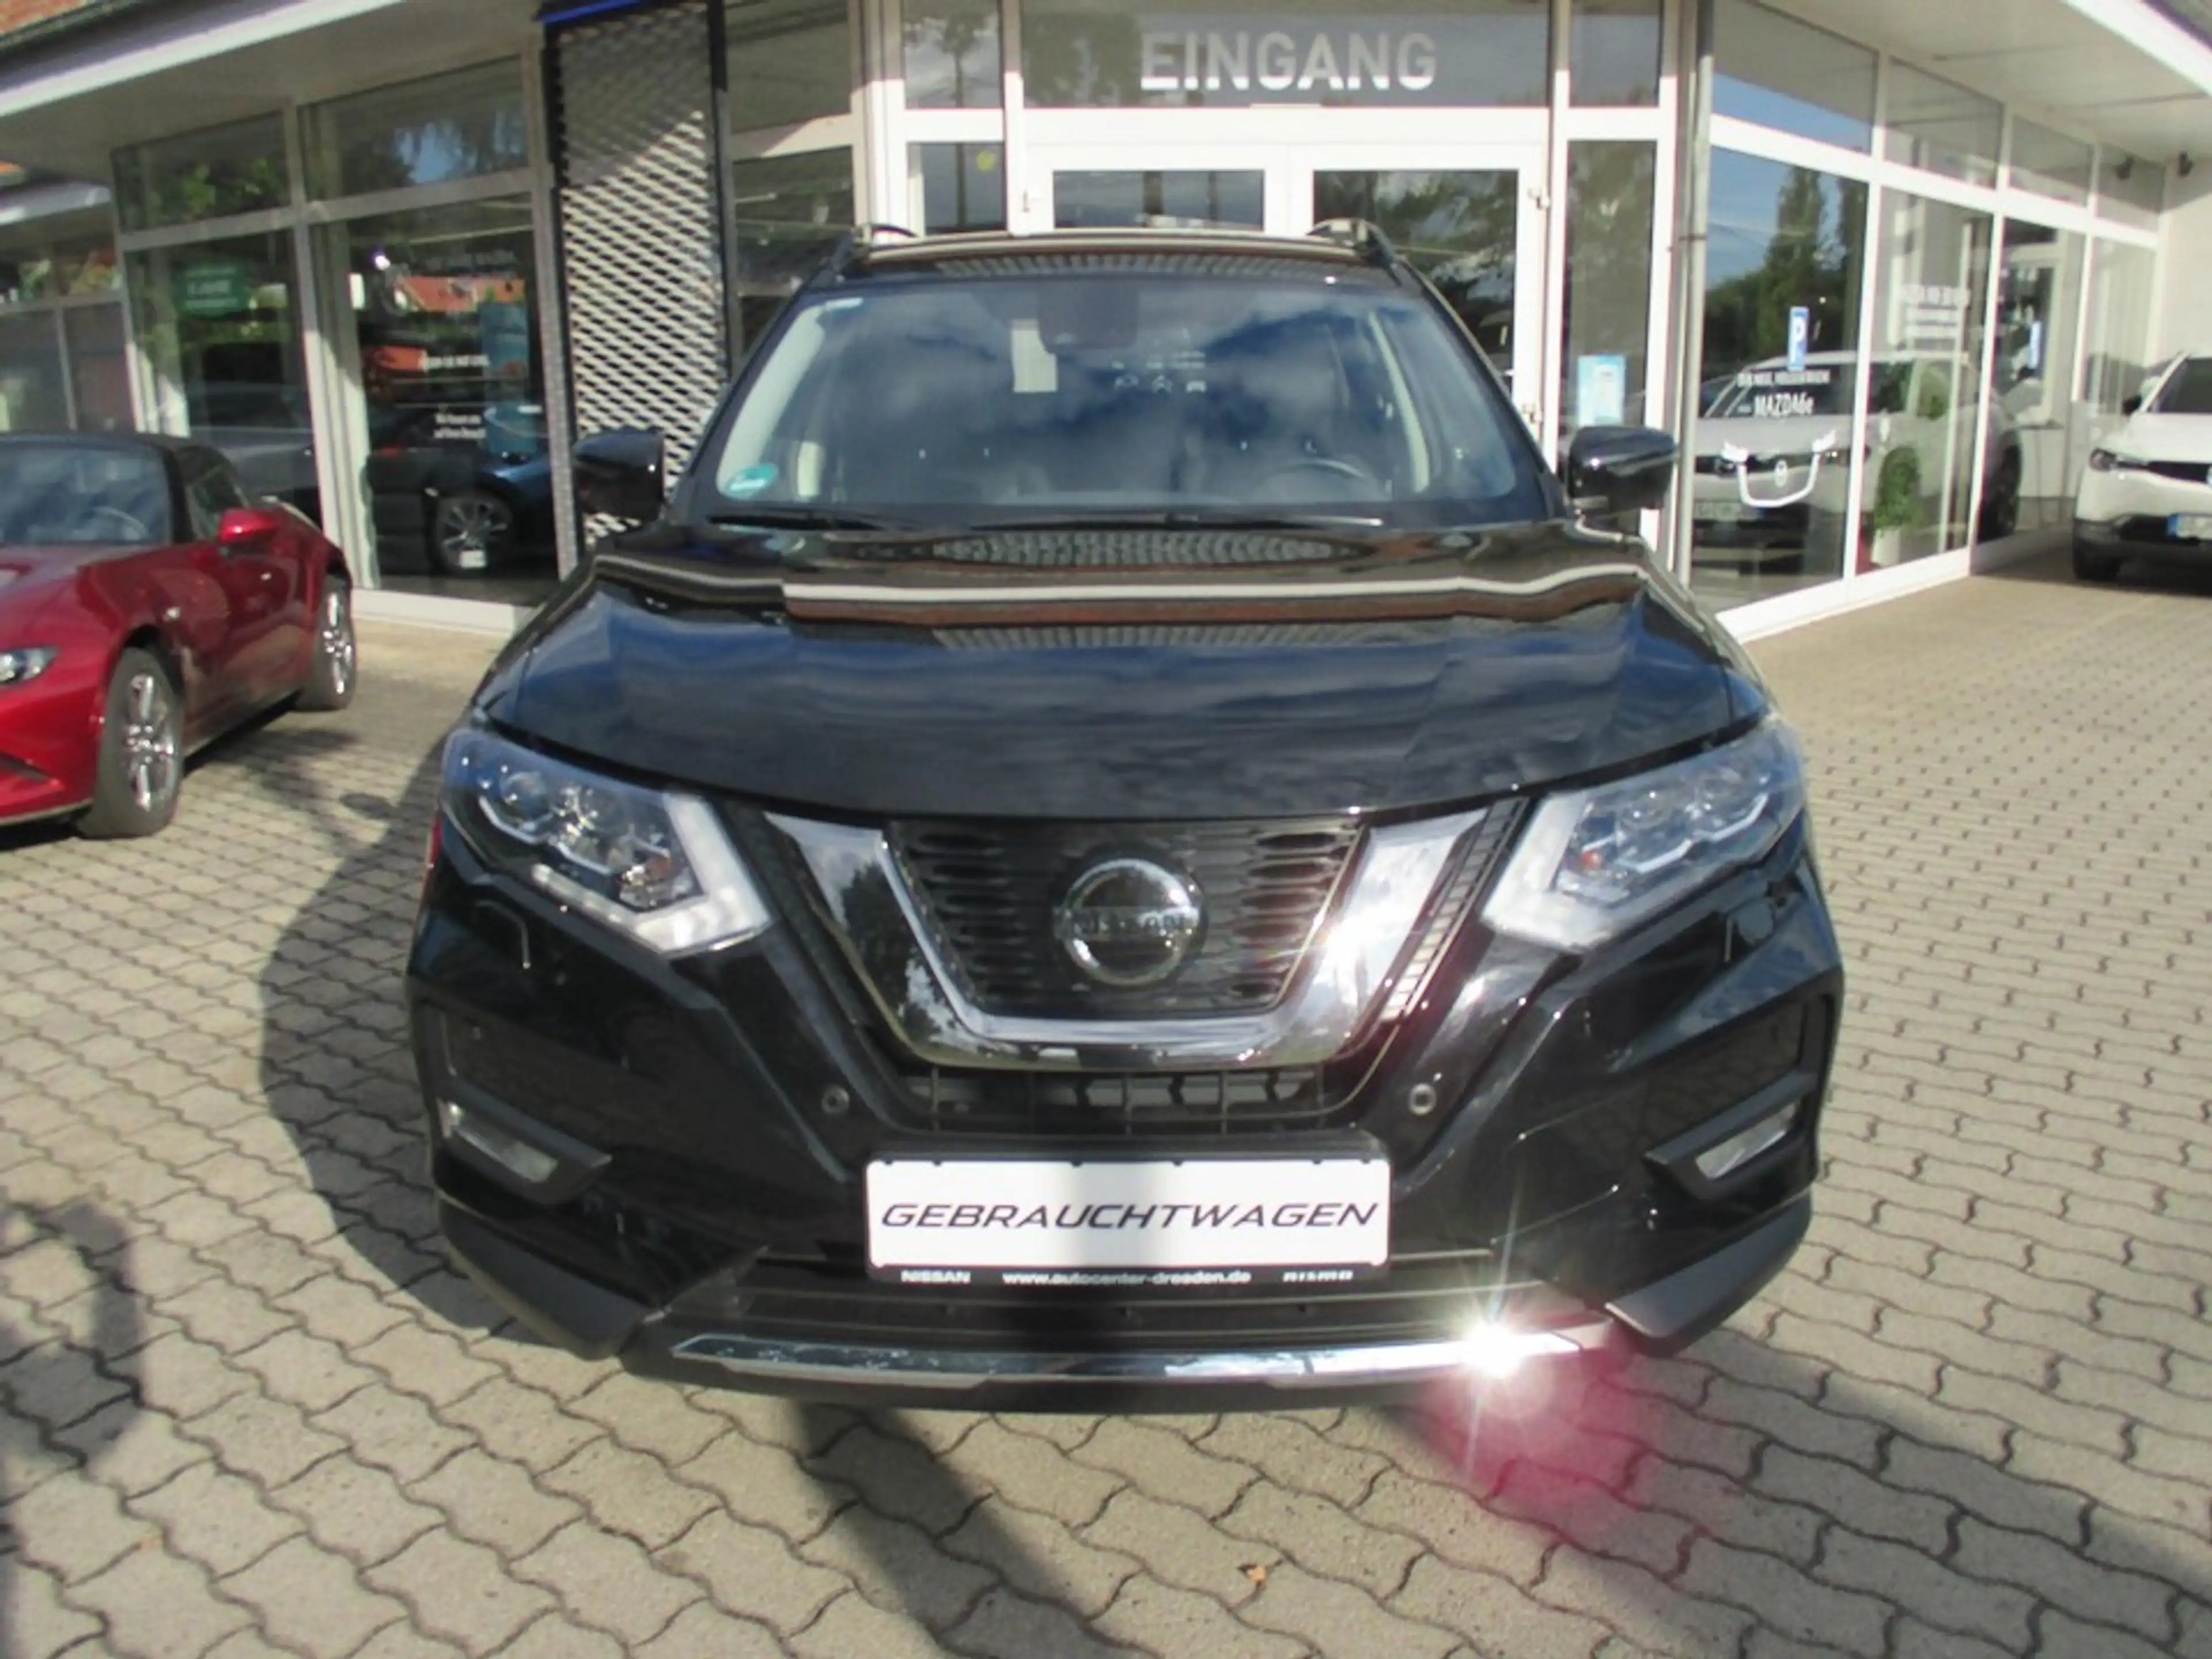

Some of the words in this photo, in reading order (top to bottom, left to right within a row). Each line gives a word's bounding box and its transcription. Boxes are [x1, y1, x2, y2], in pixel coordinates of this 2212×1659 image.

[1141, 31, 1435, 91] EINGANG
[880, 1202, 1379, 1229] GEBRAUCHTWAGEN
[900, 1270, 971, 1284] NISSAN
[1001, 1270, 1252, 1285] www.autocenter-dresden.de
